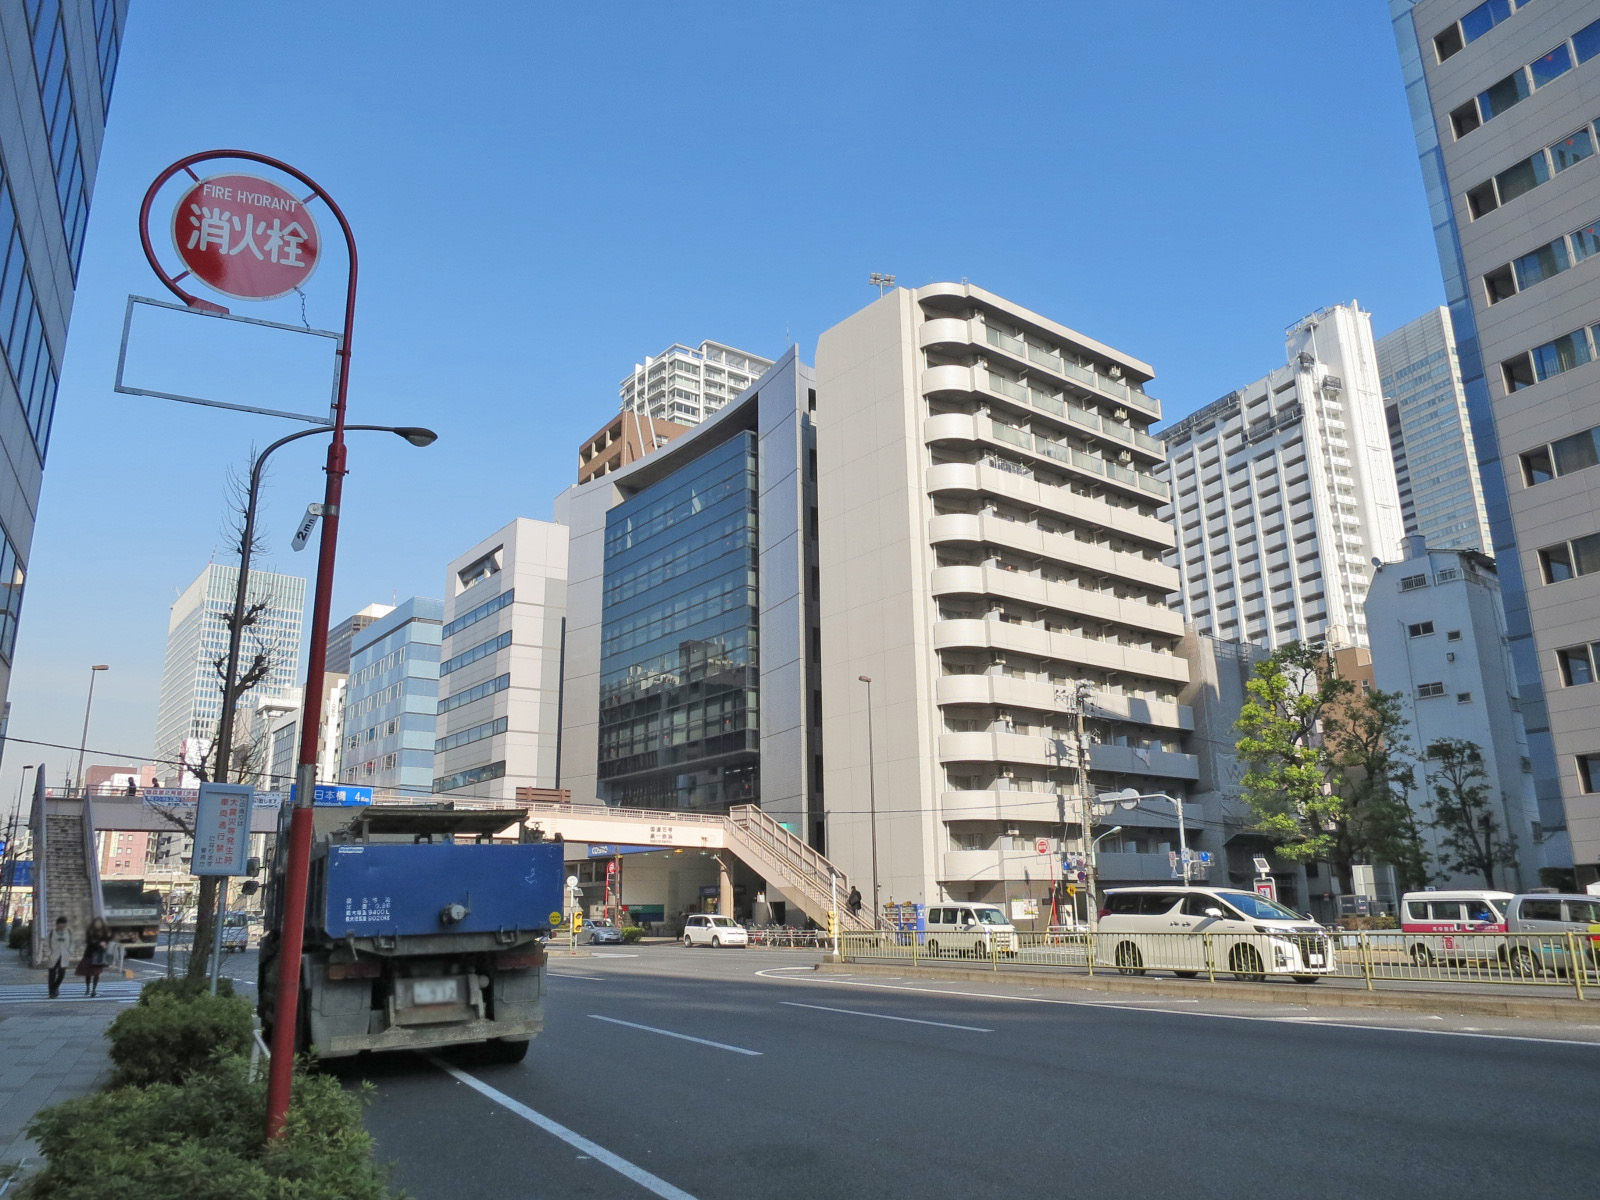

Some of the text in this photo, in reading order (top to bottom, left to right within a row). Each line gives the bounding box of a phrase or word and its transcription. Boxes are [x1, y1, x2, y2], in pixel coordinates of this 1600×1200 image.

[203, 184, 297, 212] FIRE HYDRANT
[187, 203, 308, 267] 消火栓
[314, 790, 346, 801] 日本橋
[207, 836, 216, 867] になります
[215, 799, 229, 864] 車両通行禁止
[224, 799, 238, 864] 大震災等発生時
